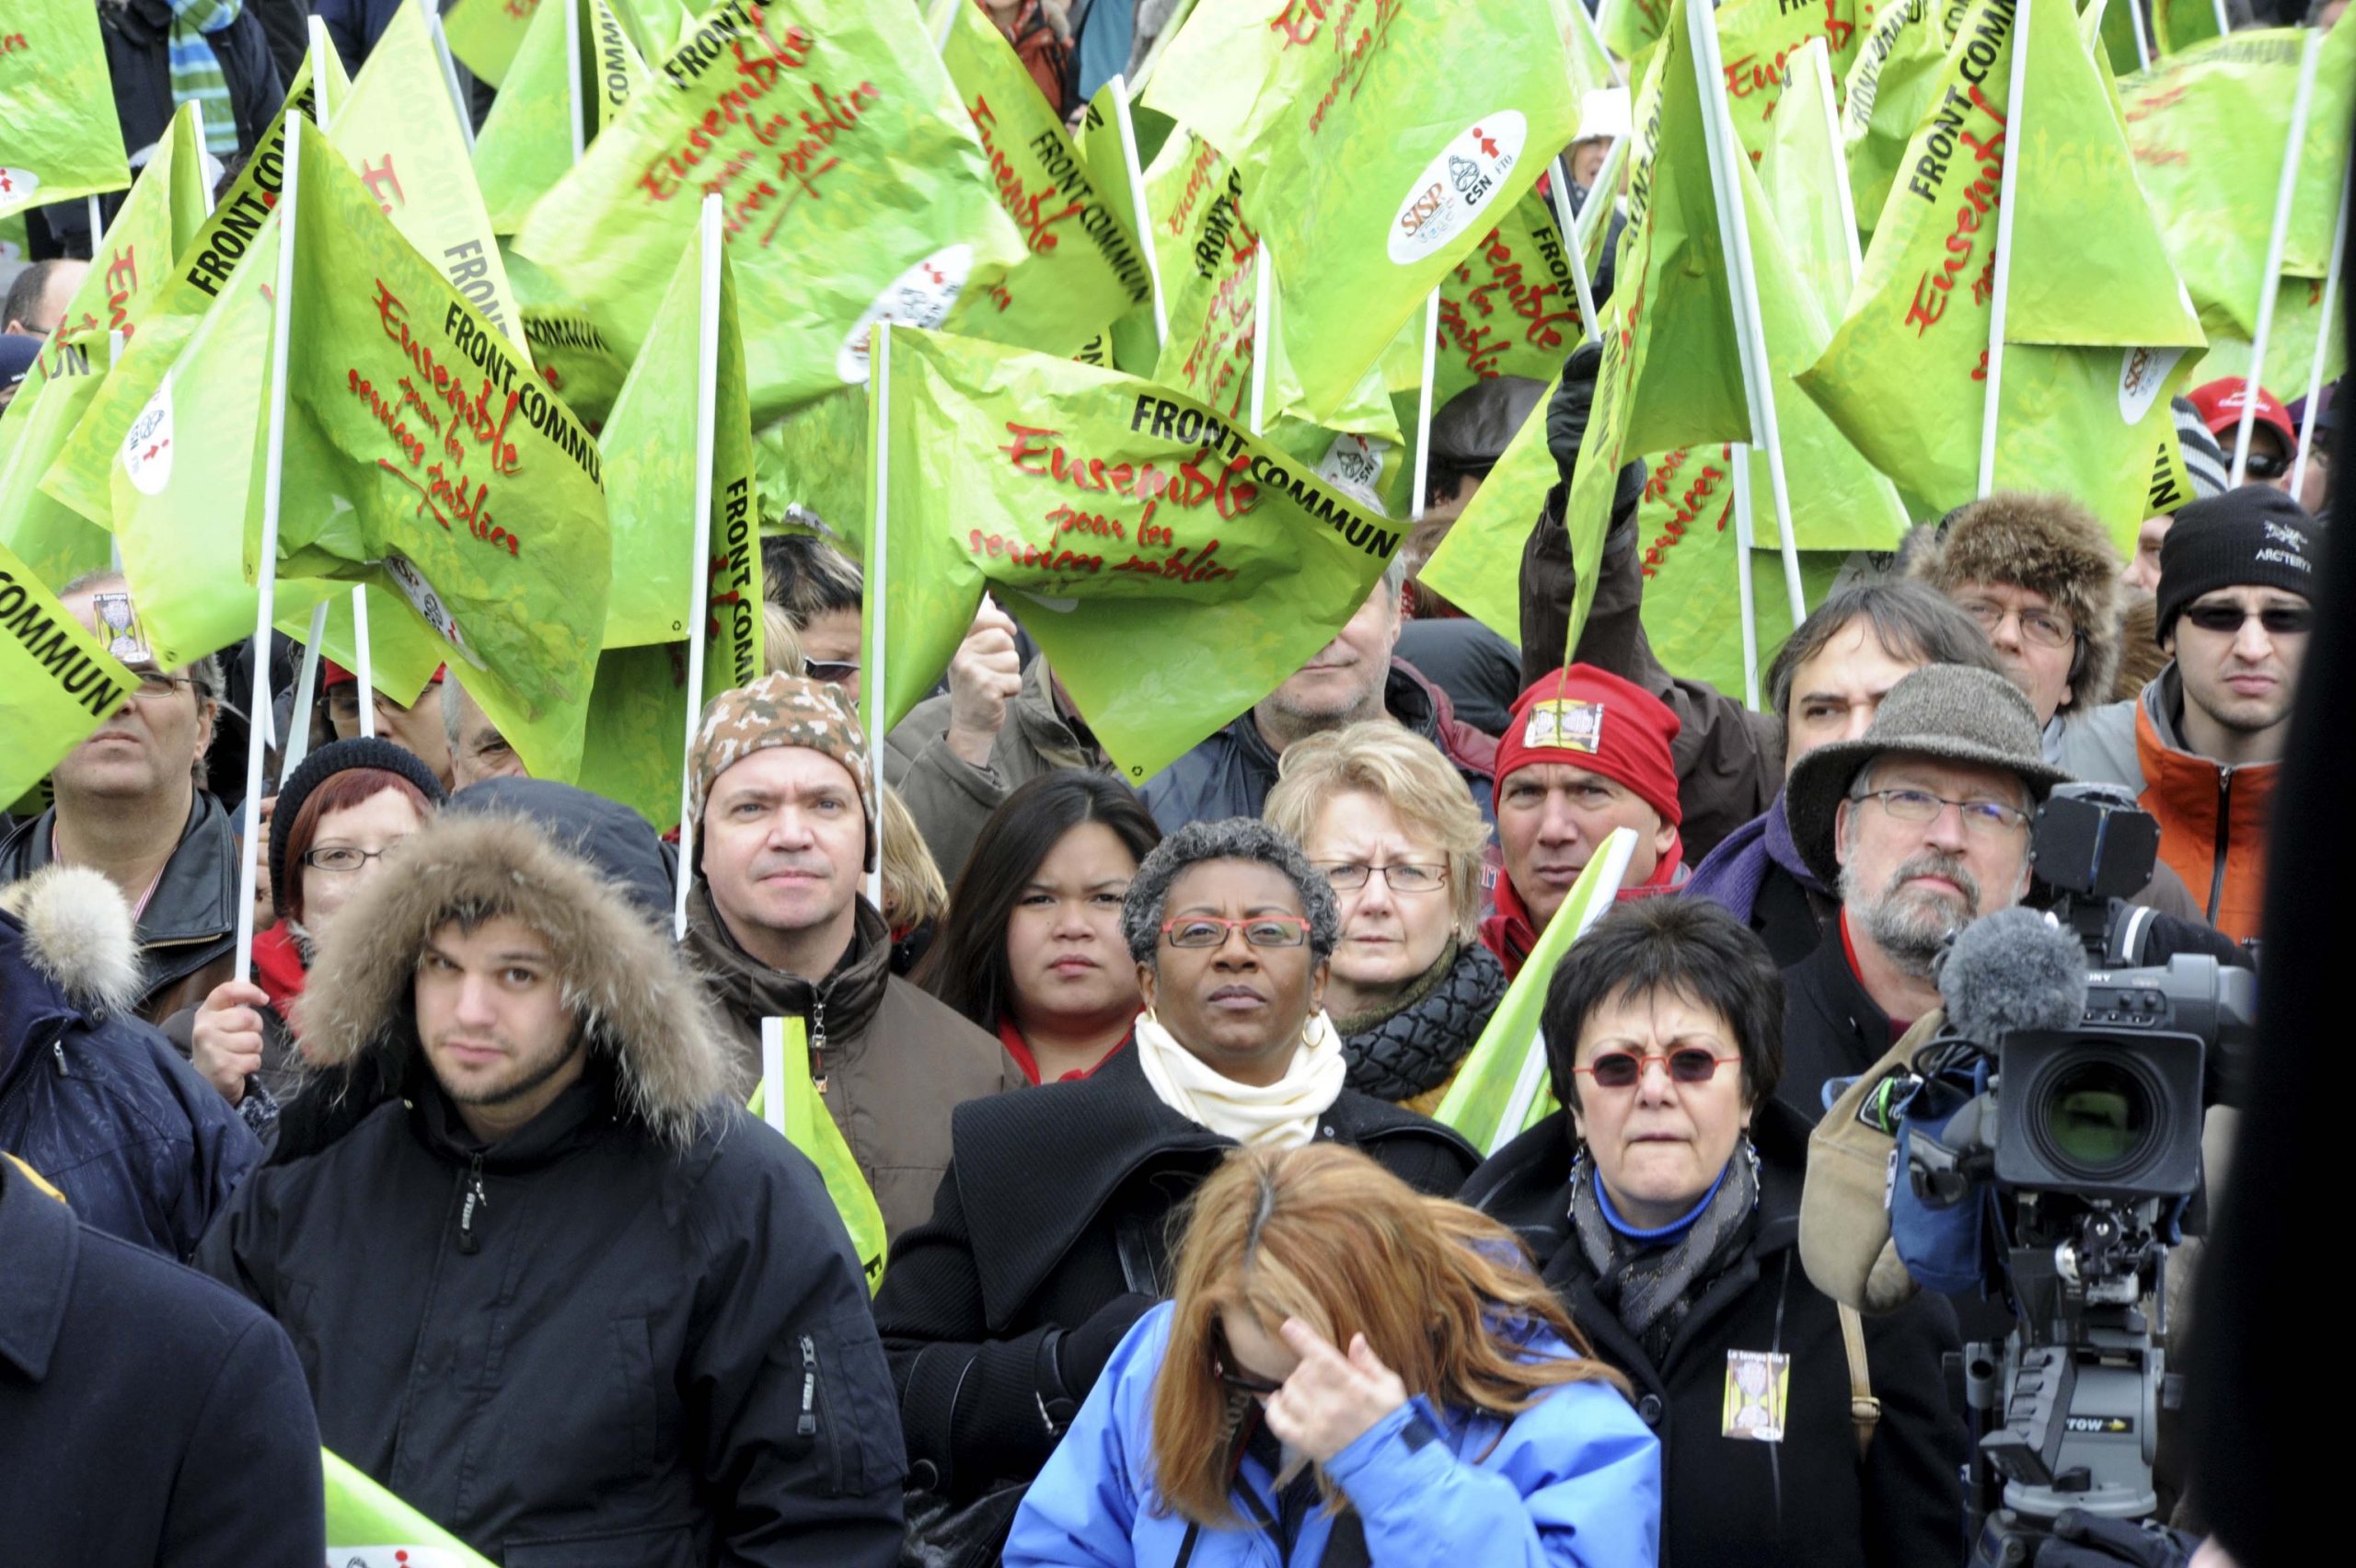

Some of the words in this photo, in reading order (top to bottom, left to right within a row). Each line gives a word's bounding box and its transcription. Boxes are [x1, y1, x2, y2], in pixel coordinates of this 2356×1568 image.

[1465, 174, 1493, 206] CSN
[1908, 84, 1973, 205] FRONT
[186, 190, 271, 298] FRONT
[348, 368, 426, 467] services
[371, 278, 524, 477] Ensemble
[444, 300, 518, 398] FRONT
[518, 381, 605, 497] COMMU
[998, 421, 1265, 522] Ensemble
[1130, 394, 1251, 462] FRONT
[1250, 455, 1403, 560] COMMUN
[726, 477, 752, 591] FRONT
[968, 527, 1103, 573] services
[1045, 502, 1125, 549] pour
[1137, 502, 1172, 549] les
[1739, 1350, 1767, 1362] temps
